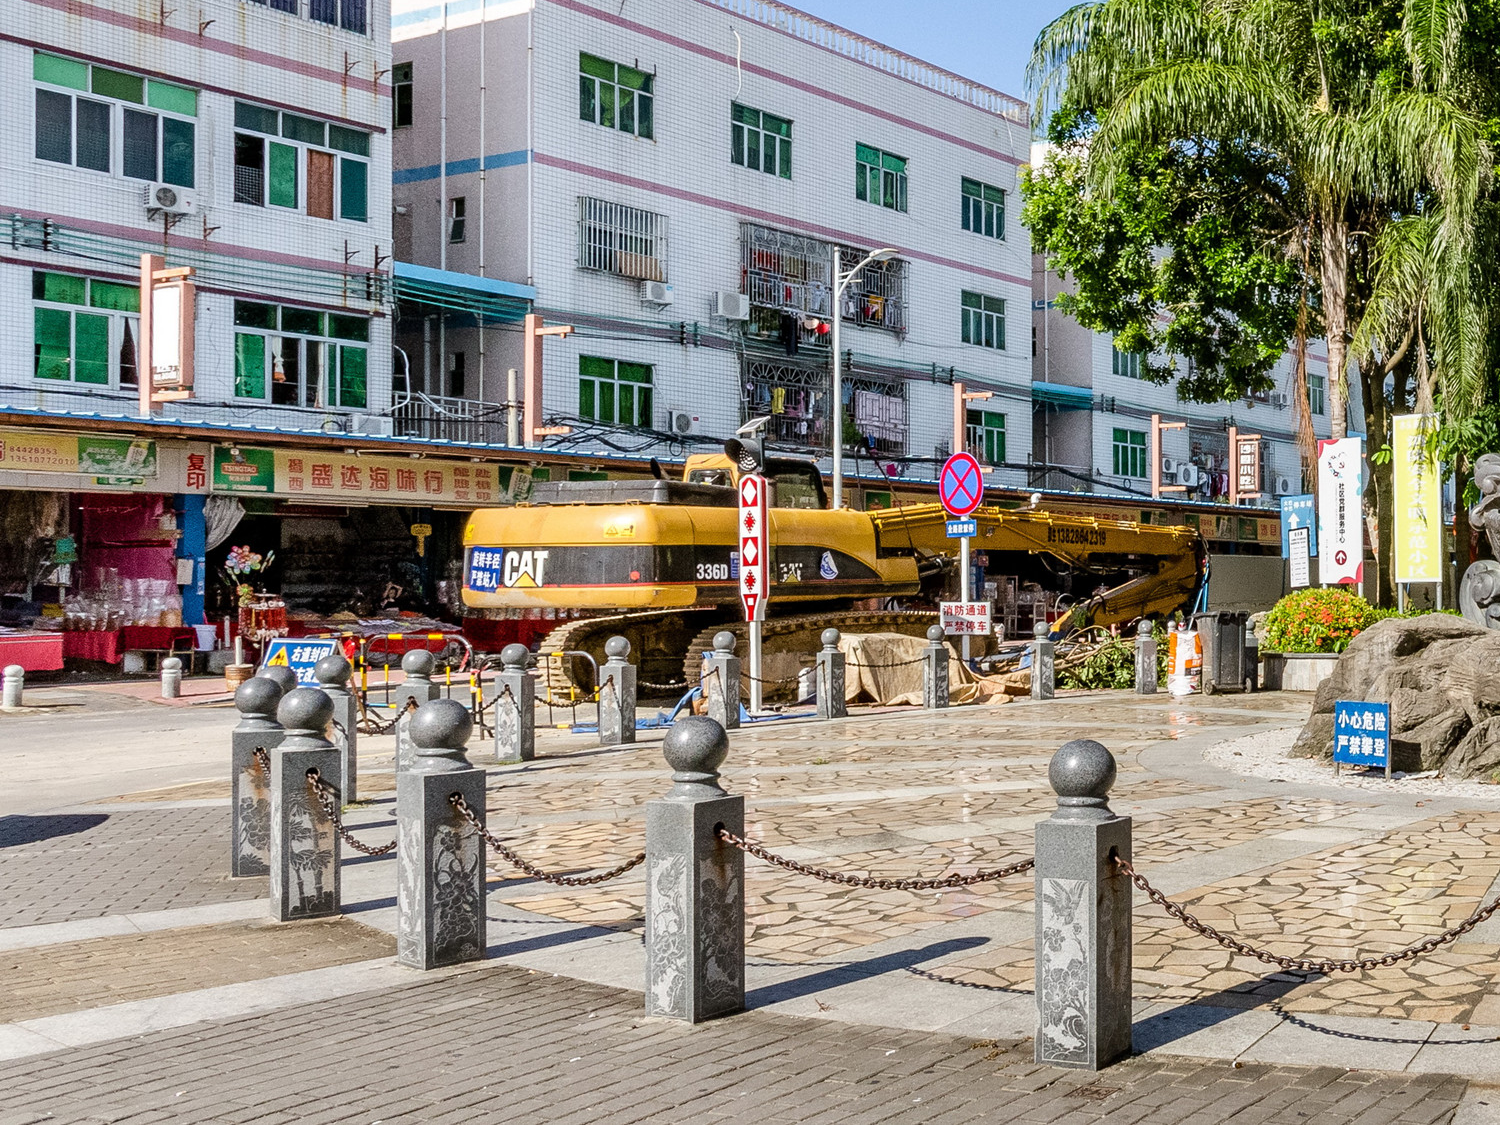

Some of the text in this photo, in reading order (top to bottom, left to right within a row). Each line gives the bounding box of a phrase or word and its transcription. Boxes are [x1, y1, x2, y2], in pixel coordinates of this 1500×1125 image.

[9, 446, 58, 455] 84428353
[10, 456, 76, 466] 13510772010
[187, 453, 206, 489] 复印
[311, 464, 443, 495] 盛达海味行
[473, 551, 501, 569] 旋转半径
[504, 551, 549, 587] CAT
[470, 570, 498, 588] 严禁站人
[696, 563, 728, 580] 336D
[943, 604, 987, 615] 消防通道
[943, 621, 987, 632] 严禁停车
[290, 666, 320, 683] 左改
[1338, 710, 1386, 731] 小心危险
[1336, 735, 1385, 757] 严禁攀登
